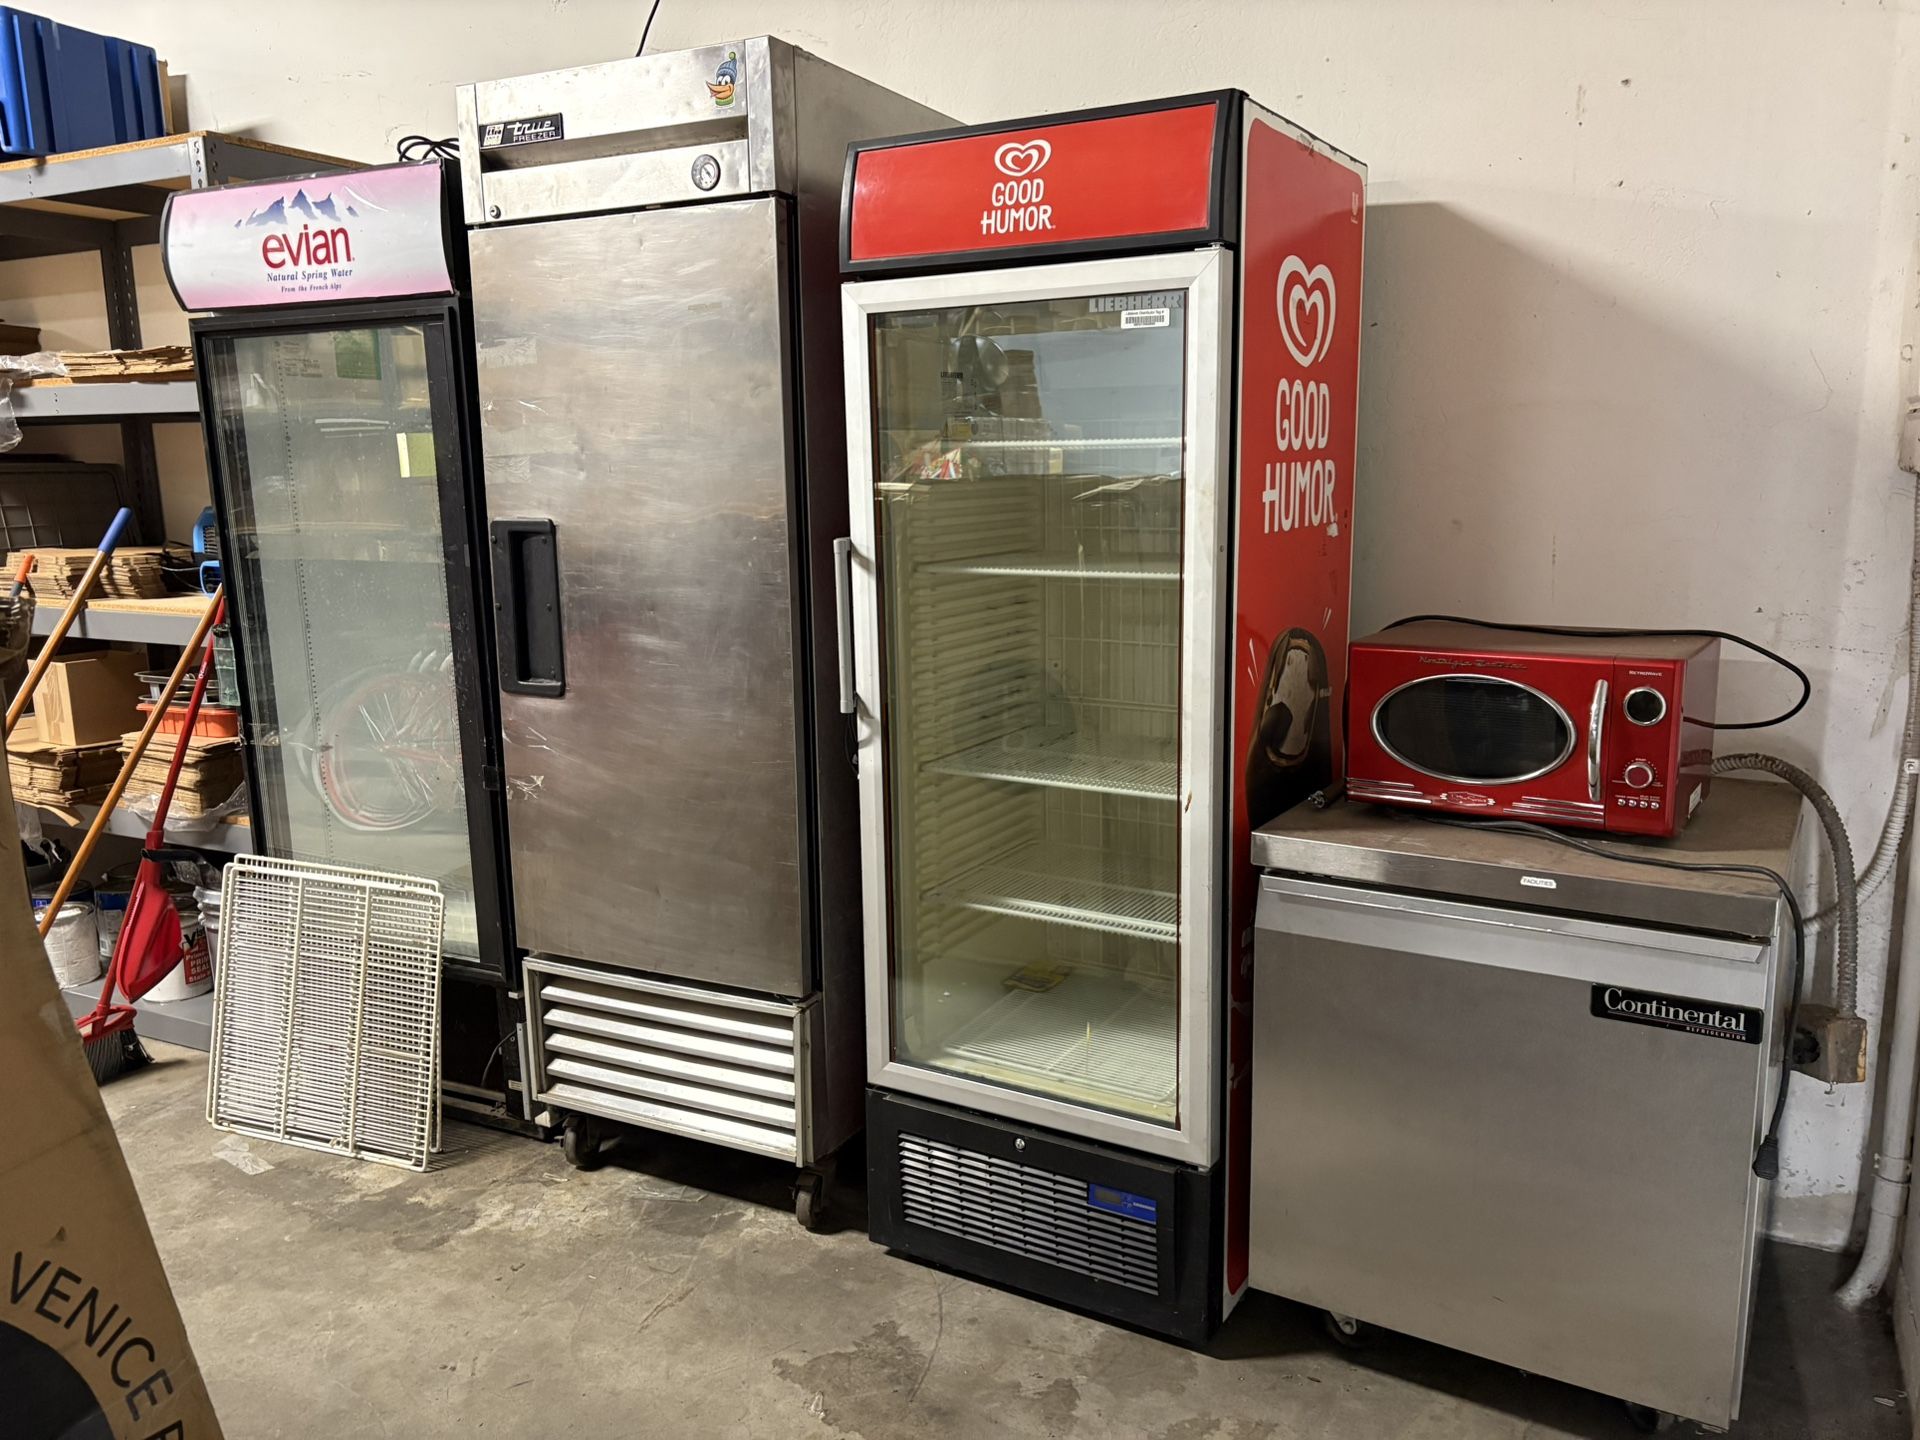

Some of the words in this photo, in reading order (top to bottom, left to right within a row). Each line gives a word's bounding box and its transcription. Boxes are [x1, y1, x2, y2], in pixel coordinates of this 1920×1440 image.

[507, 121, 555, 135] true
[513, 131, 556, 142] FREEZER
[992, 178, 1044, 207] GOOD
[980, 204, 1053, 235] HUMOR
[262, 224, 351, 269] evian
[267, 271, 298, 282] Natural
[301, 270, 328, 282] Spring
[331, 268, 353, 277] Water
[1089, 294, 1181, 312] LIEBHERR
[1275, 377, 1330, 452] GOOD
[1262, 458, 1336, 534] HUMOR
[1604, 987, 1746, 1031] Continental
[1685, 1026, 1747, 1041] REFRIGERATOR
[10, 1251, 174, 1422] VENICE
